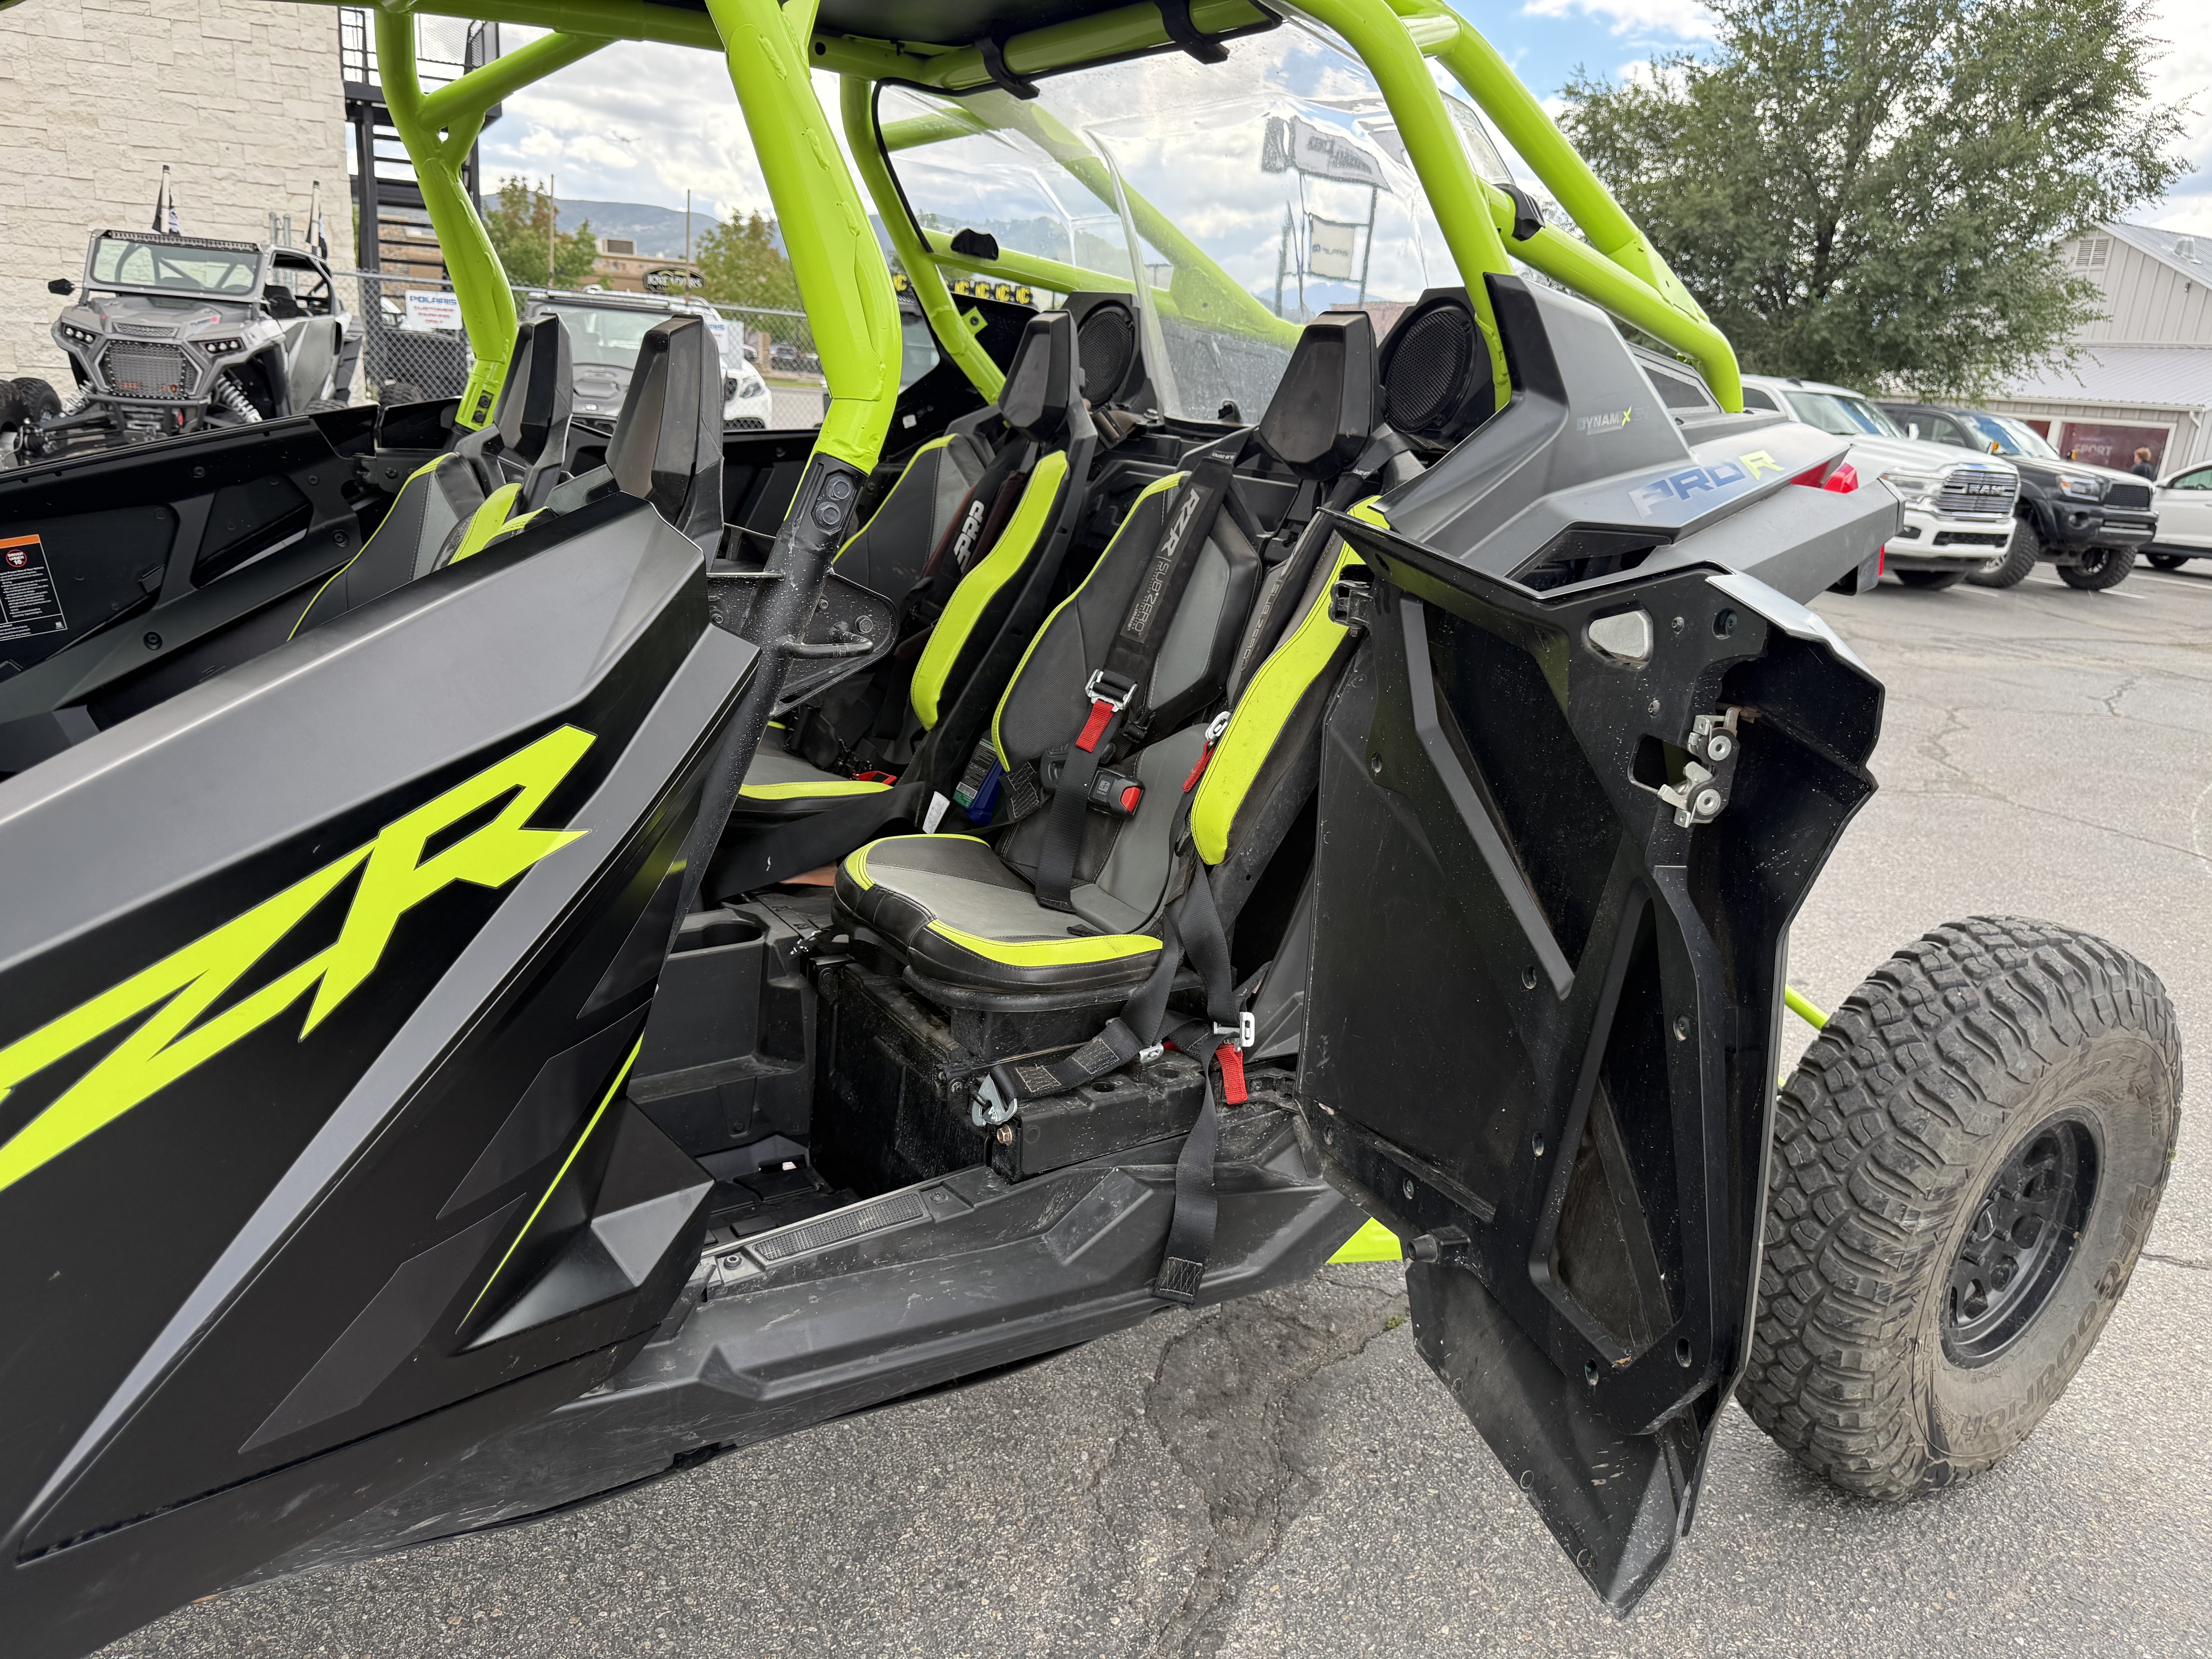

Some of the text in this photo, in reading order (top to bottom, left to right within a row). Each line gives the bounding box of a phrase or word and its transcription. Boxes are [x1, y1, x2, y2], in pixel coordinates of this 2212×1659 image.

[409, 295, 457, 305] POLARIS
[1628, 450, 1785, 519] PRO R
[1969, 484, 2005, 495] RAM
[953, 500, 985, 574] PRP
[1161, 488, 1200, 556] RZR
[1152, 562, 1169, 592] SUB
[1960, 1184, 2152, 1441] BFGoodrich
